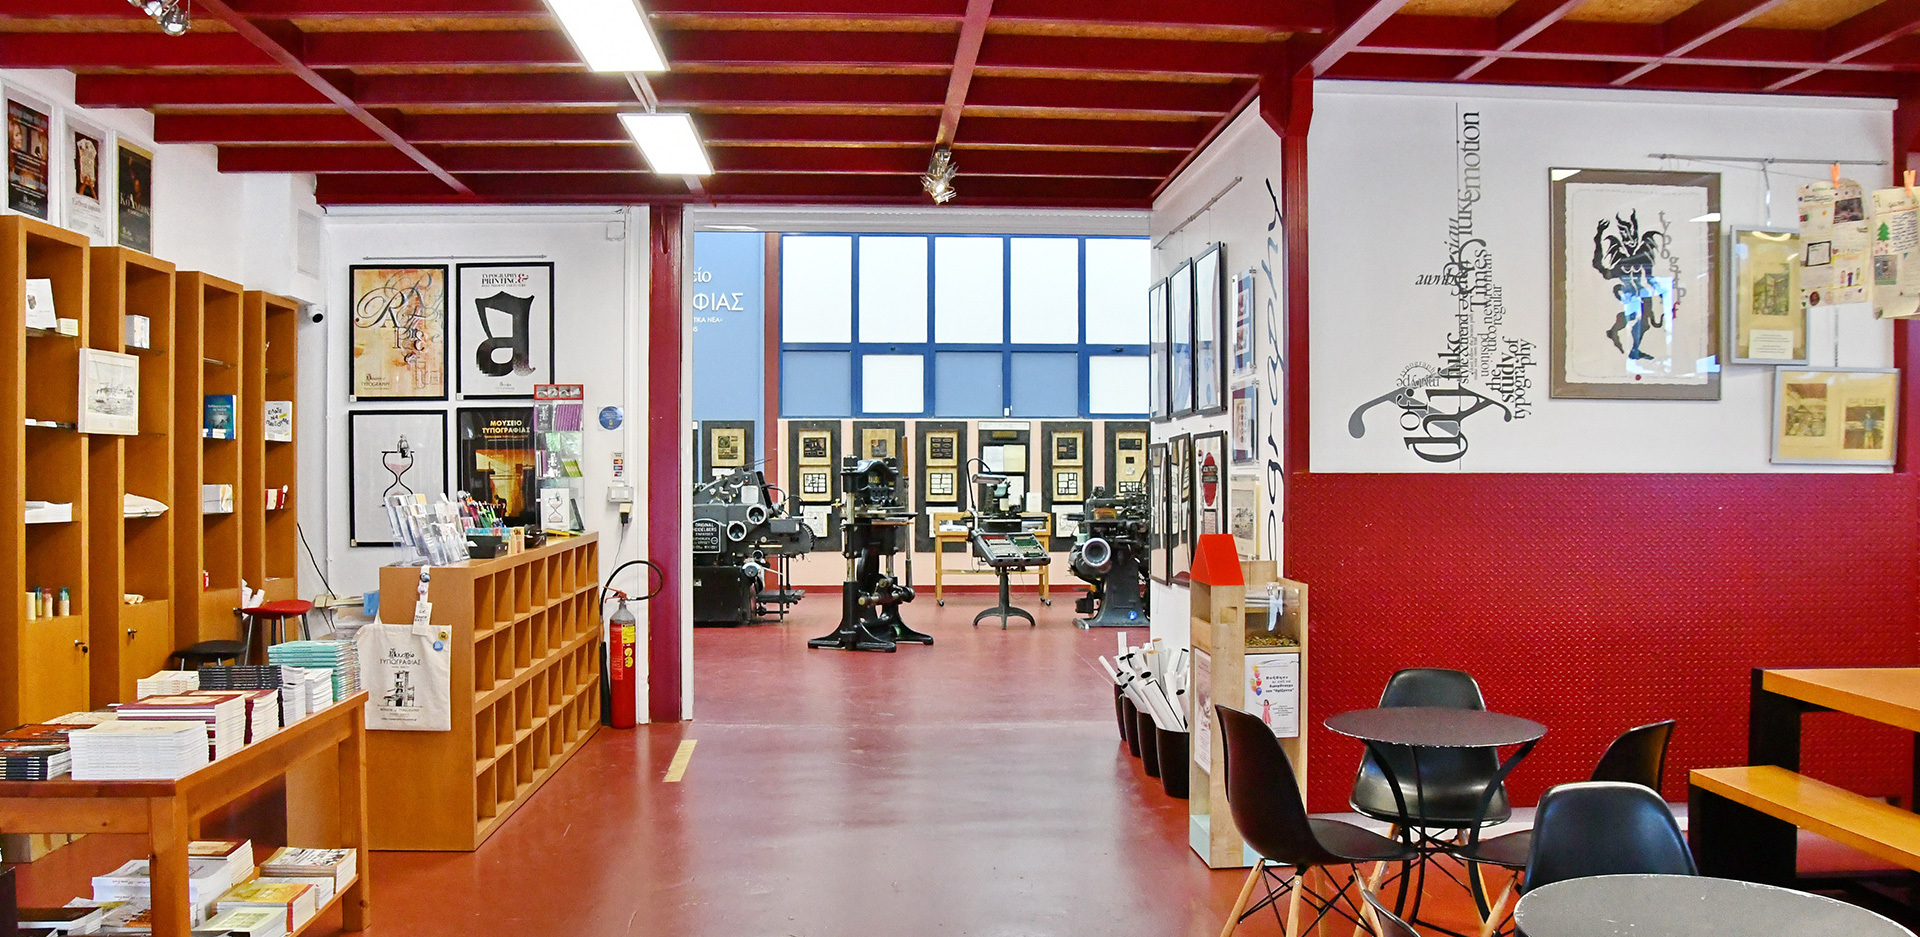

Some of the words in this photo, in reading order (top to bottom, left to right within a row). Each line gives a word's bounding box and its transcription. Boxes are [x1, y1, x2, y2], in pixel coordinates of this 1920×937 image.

[1456, 111, 1481, 202] emotion
[693, 292, 744, 311] ΦΙΑΣ
[1470, 249, 1488, 312] Times
[1491, 284, 1506, 326] regular
[1502, 336, 1519, 353] of
[1485, 369, 1502, 391] the
[1496, 353, 1520, 403] study
